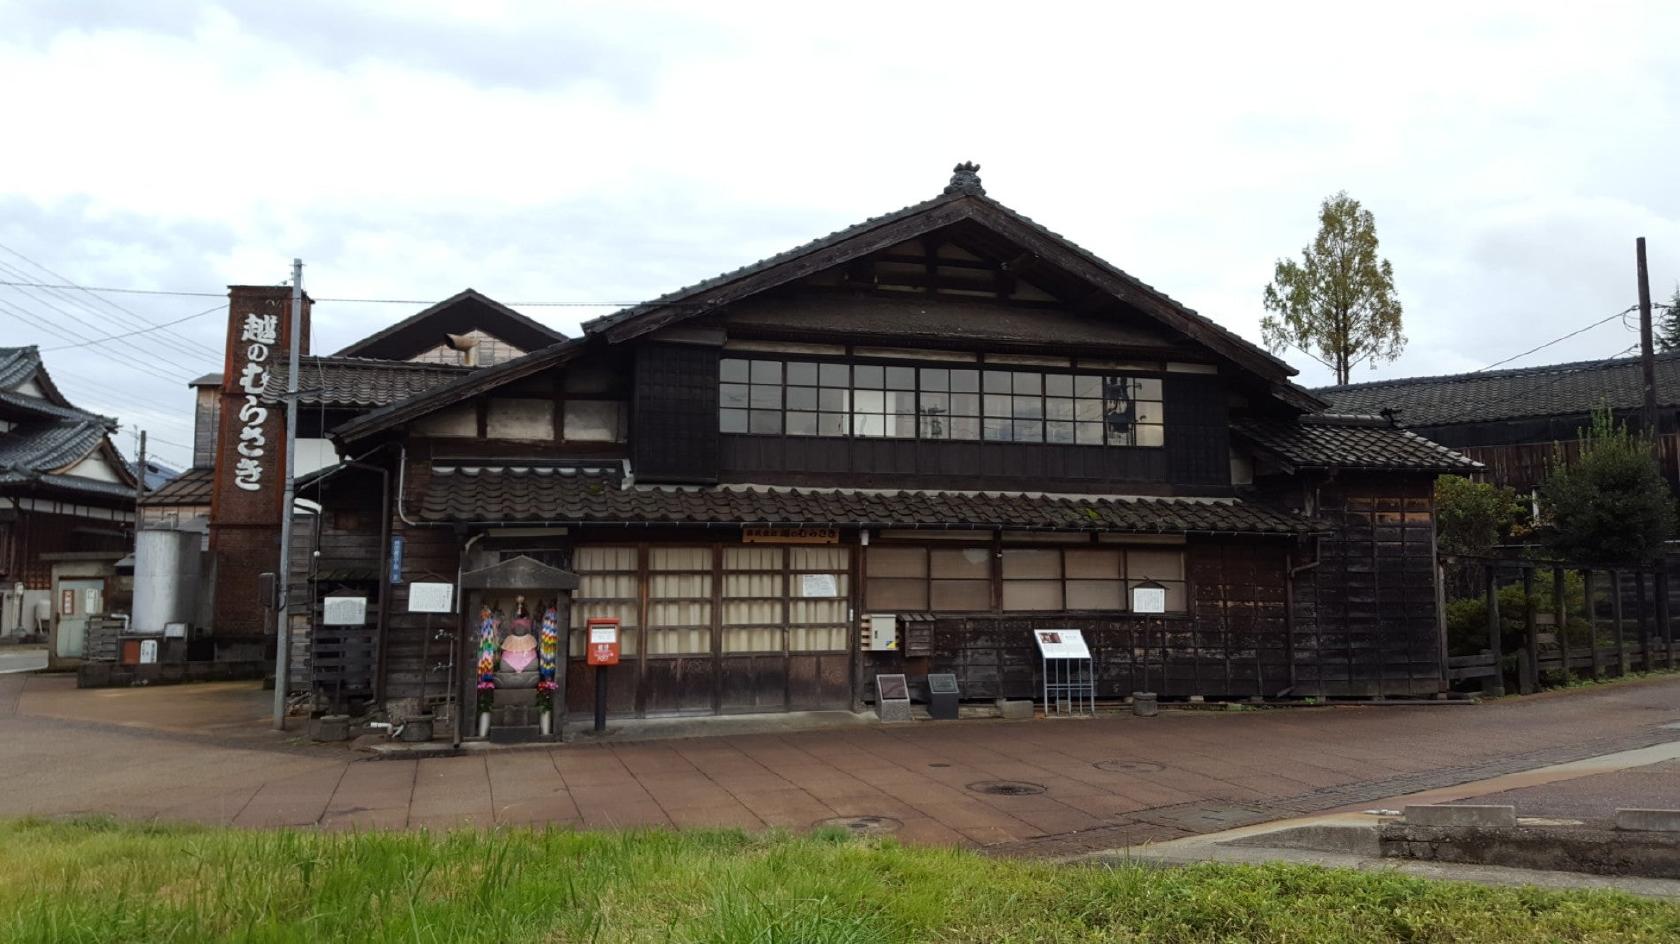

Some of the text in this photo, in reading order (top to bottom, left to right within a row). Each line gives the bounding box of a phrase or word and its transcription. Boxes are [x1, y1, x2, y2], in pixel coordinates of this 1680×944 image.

[235, 313, 279, 491] 越のむらさき
